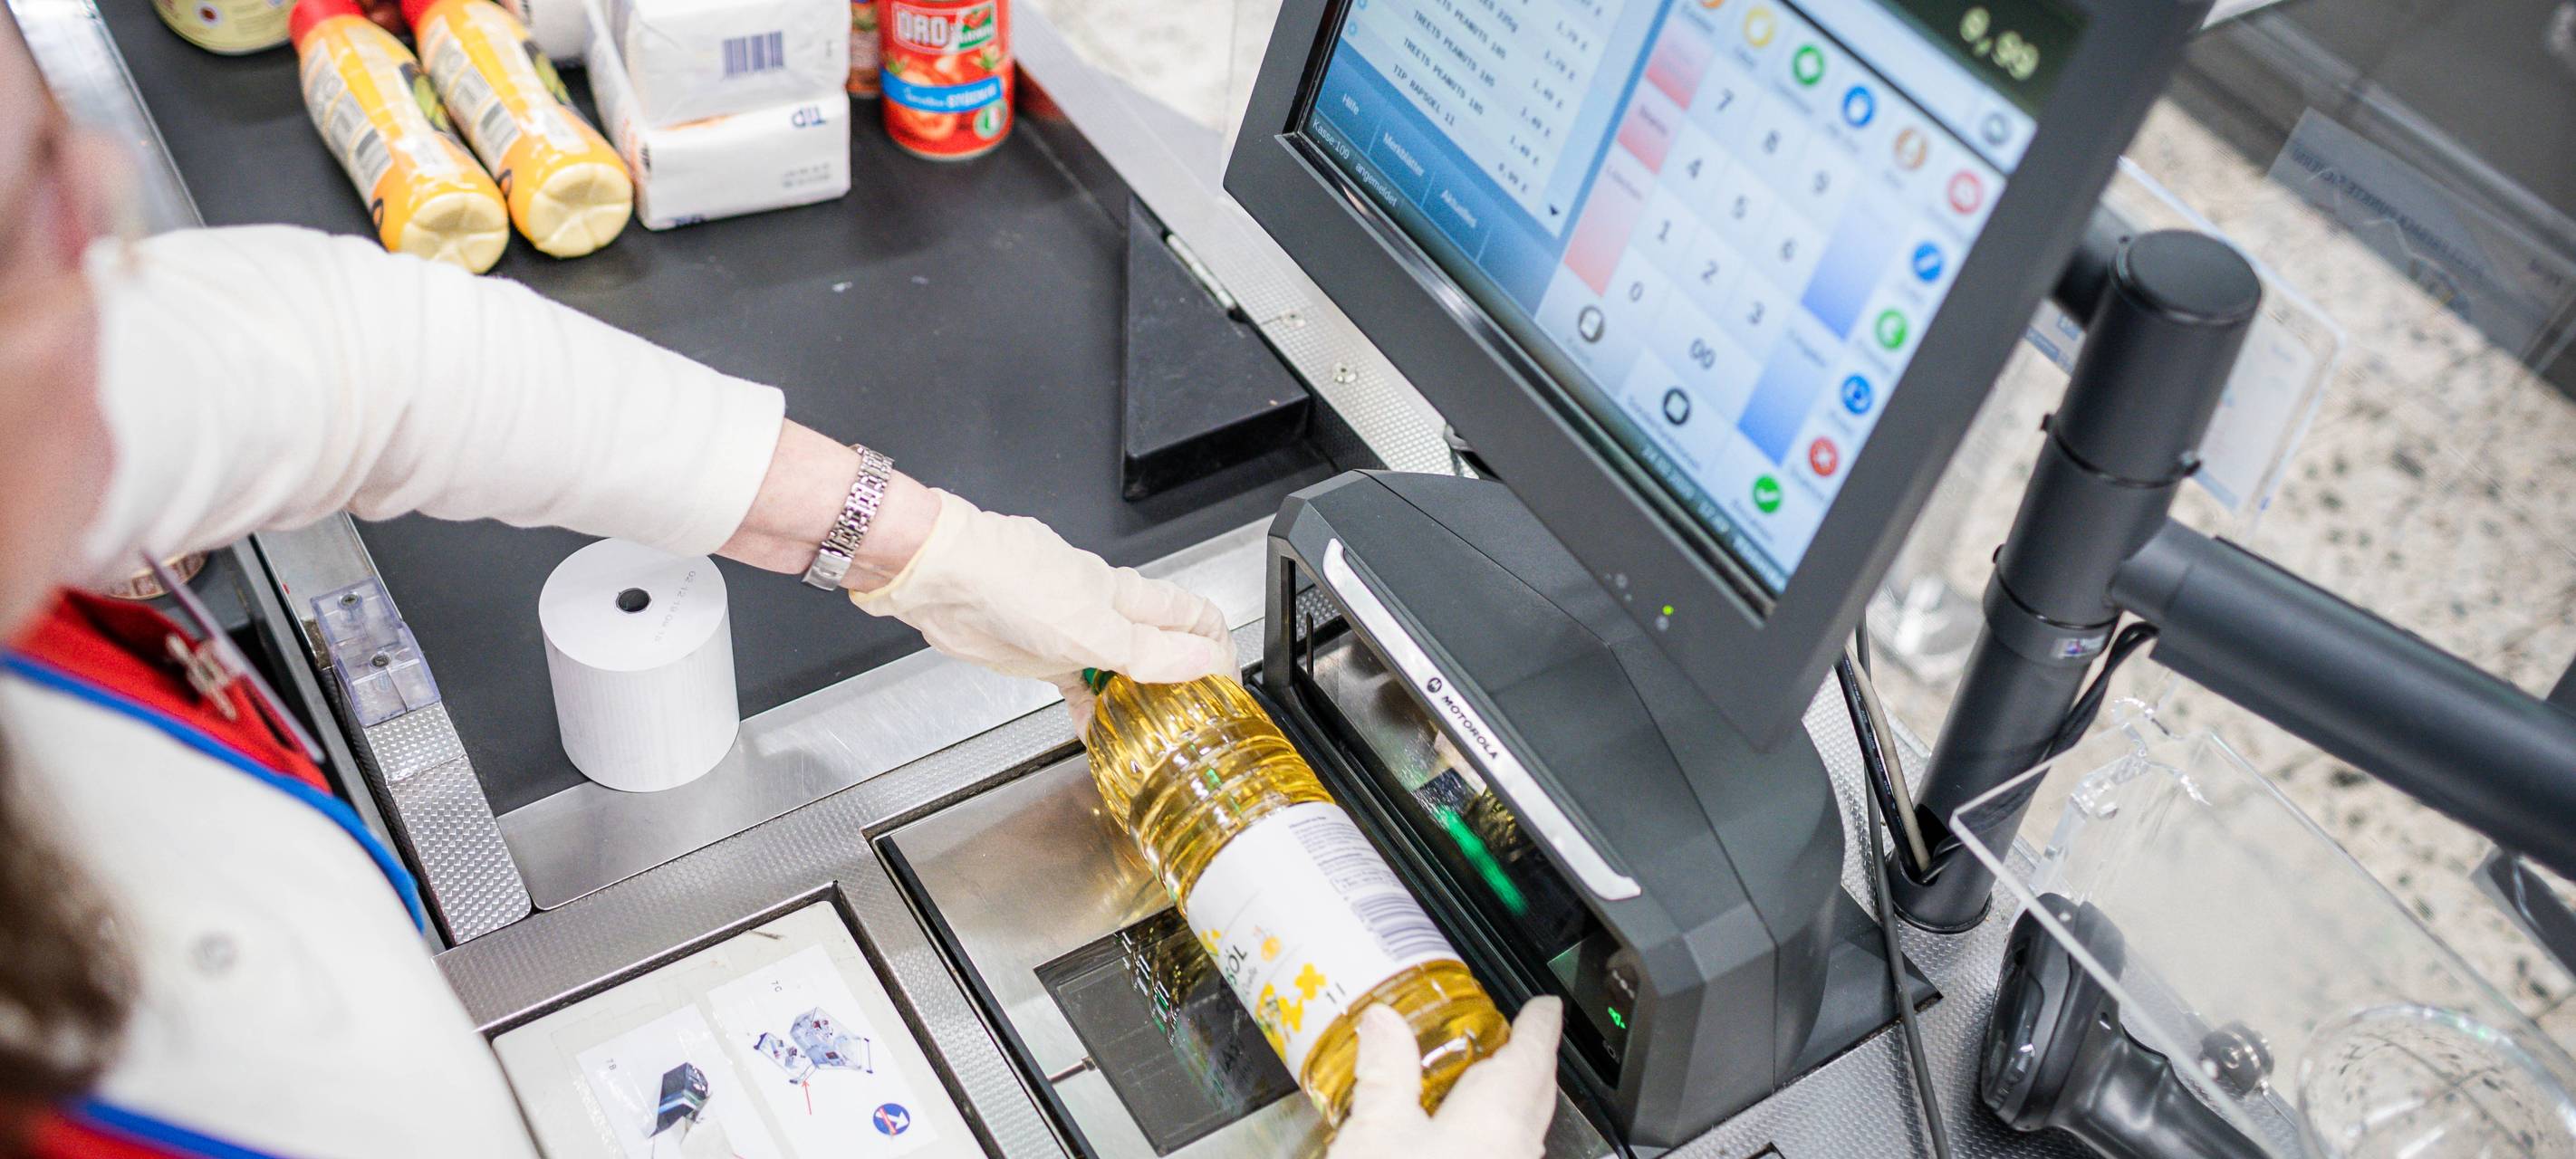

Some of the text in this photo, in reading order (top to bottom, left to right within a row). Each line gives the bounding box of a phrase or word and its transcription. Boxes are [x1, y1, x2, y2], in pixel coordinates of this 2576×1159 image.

[897, 9, 948, 49] ORO
[1414, 9, 1441, 39] TREETS
[1443, 35, 1477, 72] PEANUTS
[1393, 63, 1408, 80] TIP
[1404, 37, 1430, 67] TREETS
[1433, 63, 1466, 100] PEANUTS
[1717, 88, 1735, 112] 7
[1686, 157, 1704, 181] 4
[1658, 218, 1764, 326] 1 2 3
[1629, 280, 1717, 370] 0 00
[1442, 695, 1498, 759] MOTOROLA
